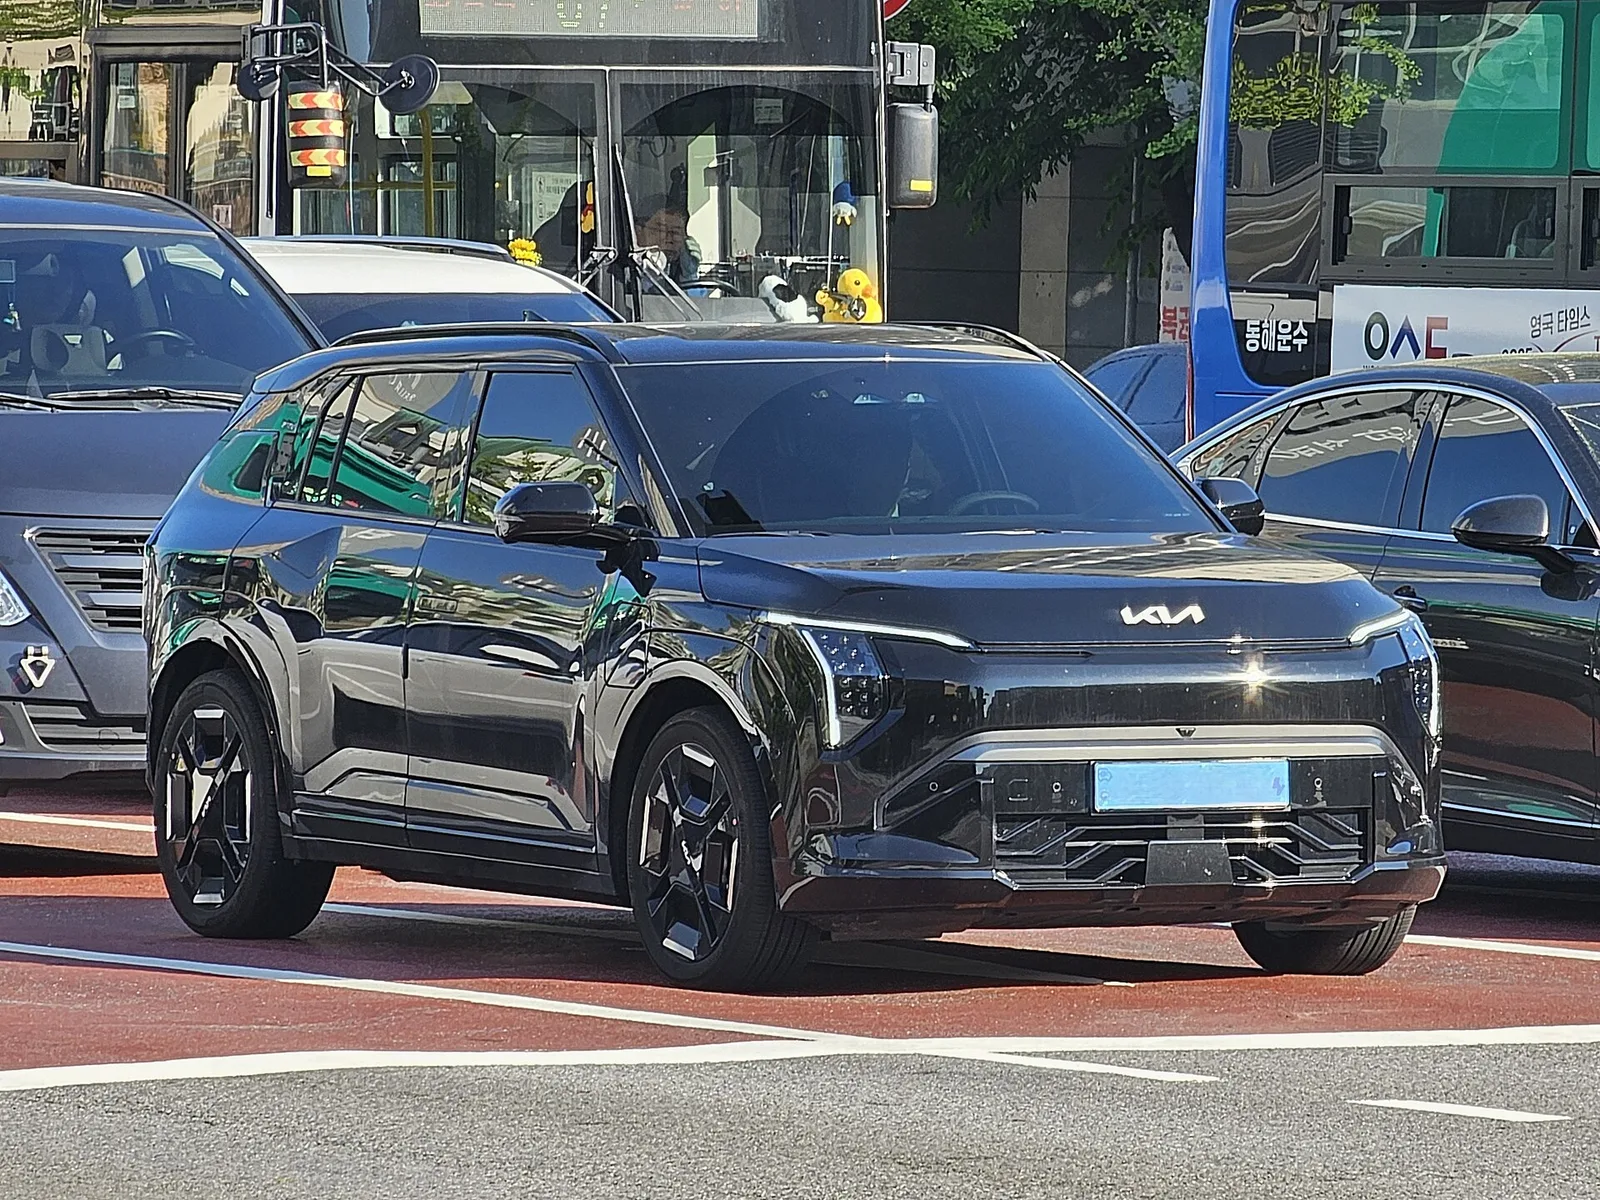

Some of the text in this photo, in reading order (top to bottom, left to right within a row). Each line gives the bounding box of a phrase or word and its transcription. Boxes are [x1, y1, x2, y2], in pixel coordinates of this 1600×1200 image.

[1245, 318, 1309, 353] 동해운수
[1530, 304, 1591, 339] 영국 타임스
[1120, 604, 1206, 625] KIA
